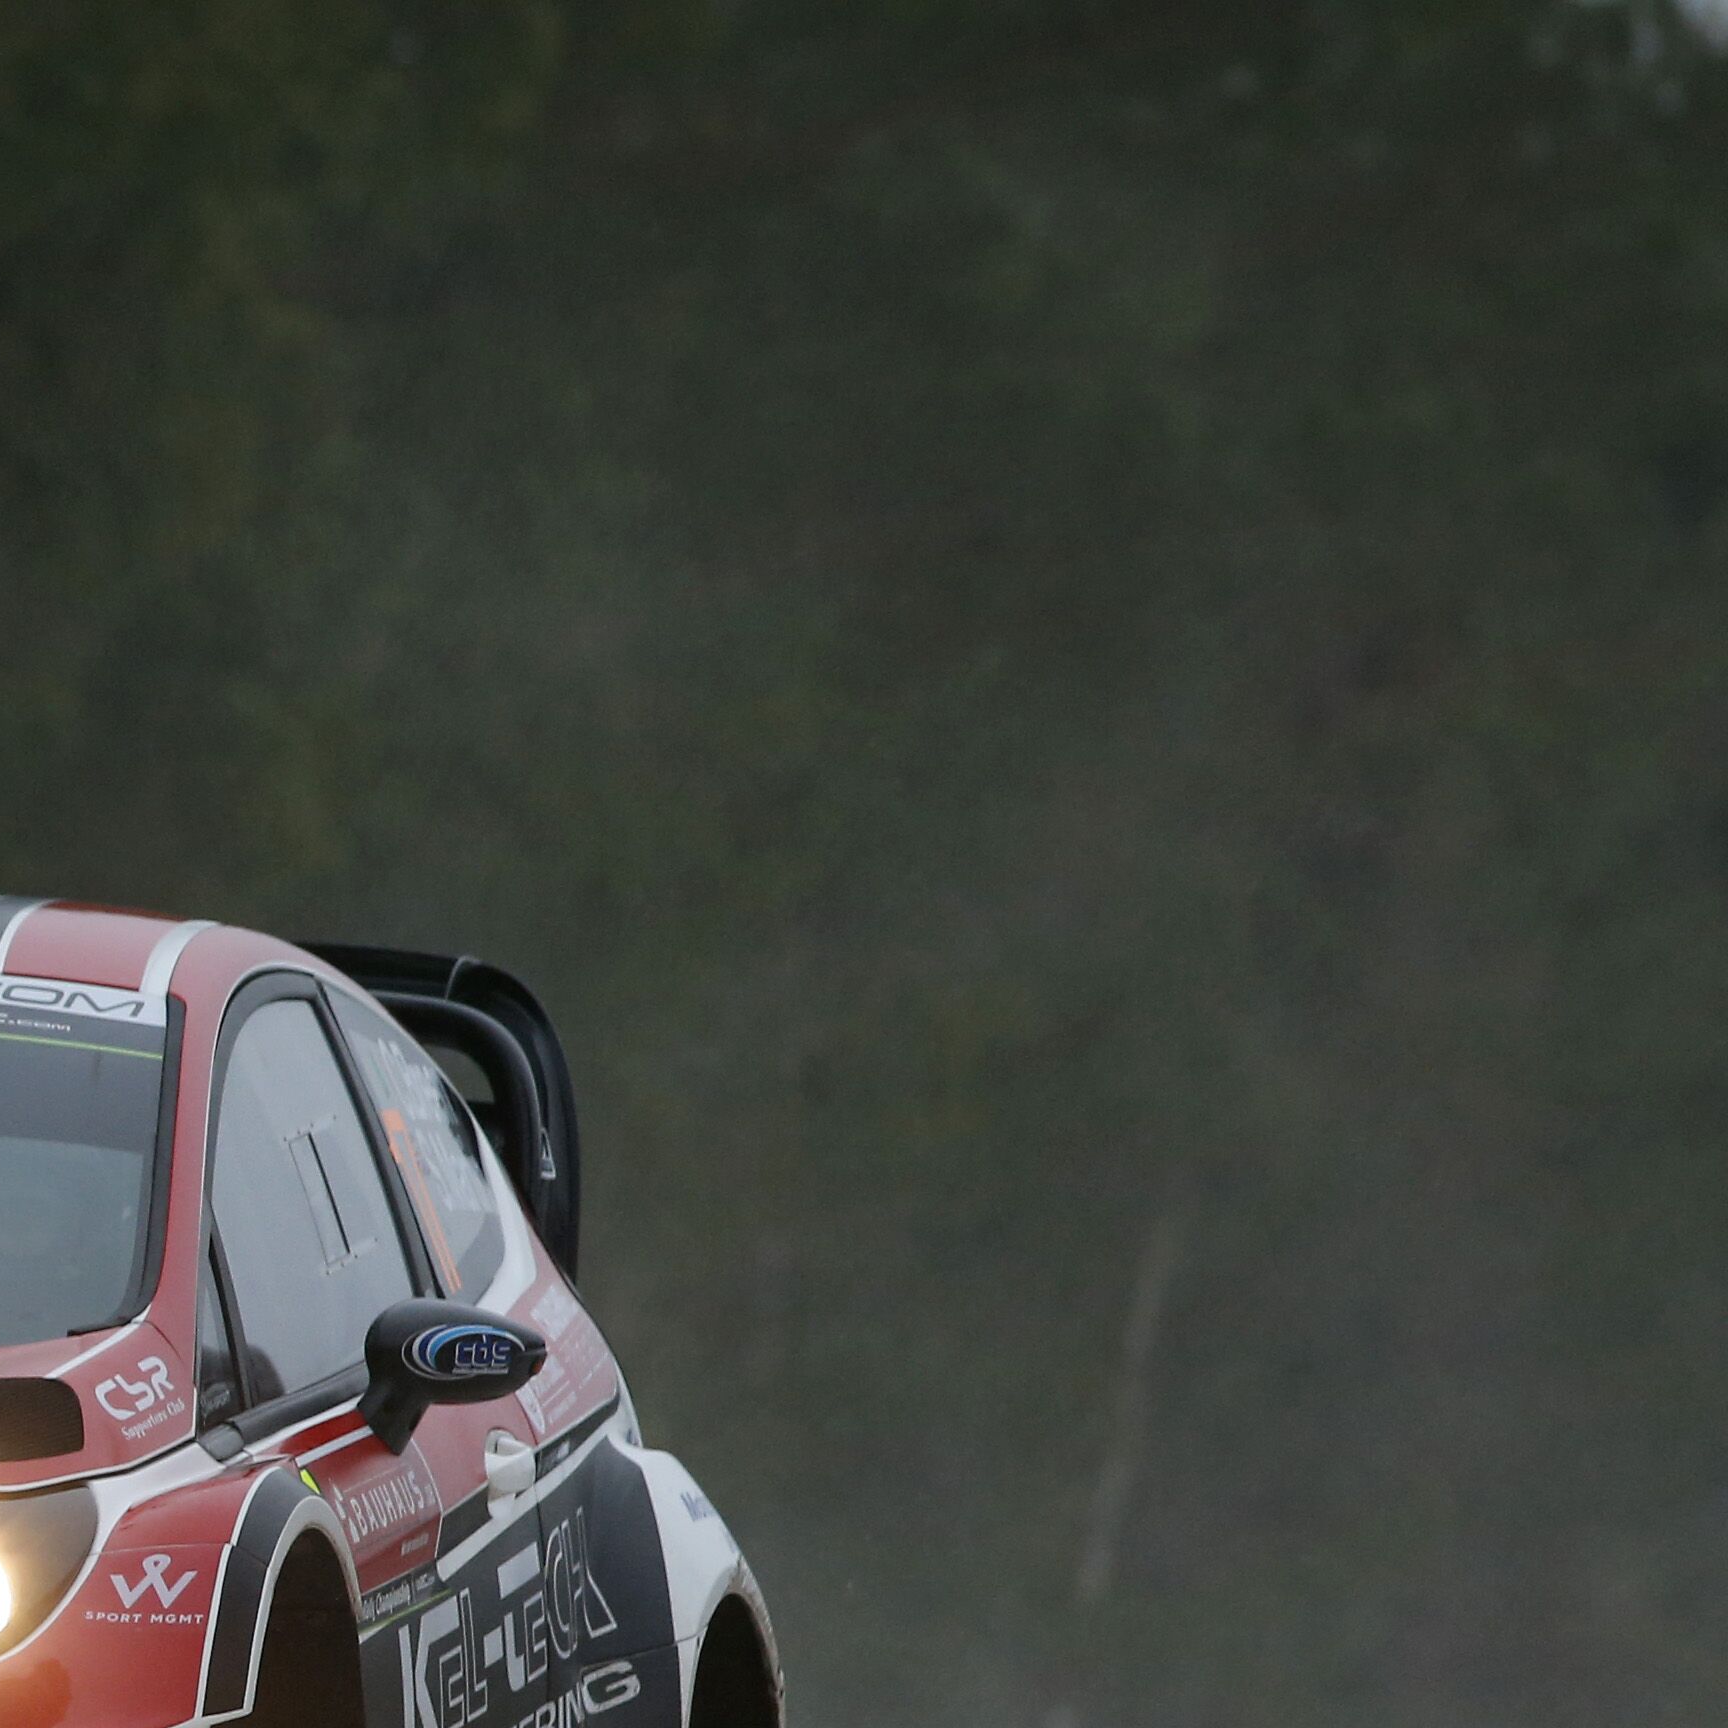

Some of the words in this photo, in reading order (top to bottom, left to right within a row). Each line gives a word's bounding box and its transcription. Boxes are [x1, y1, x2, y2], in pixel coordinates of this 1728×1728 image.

[350, 1470, 425, 1537] BAUHAUS
[85, 1610, 142, 1624] SPORT
[150, 1613, 204, 1625] MGMT
